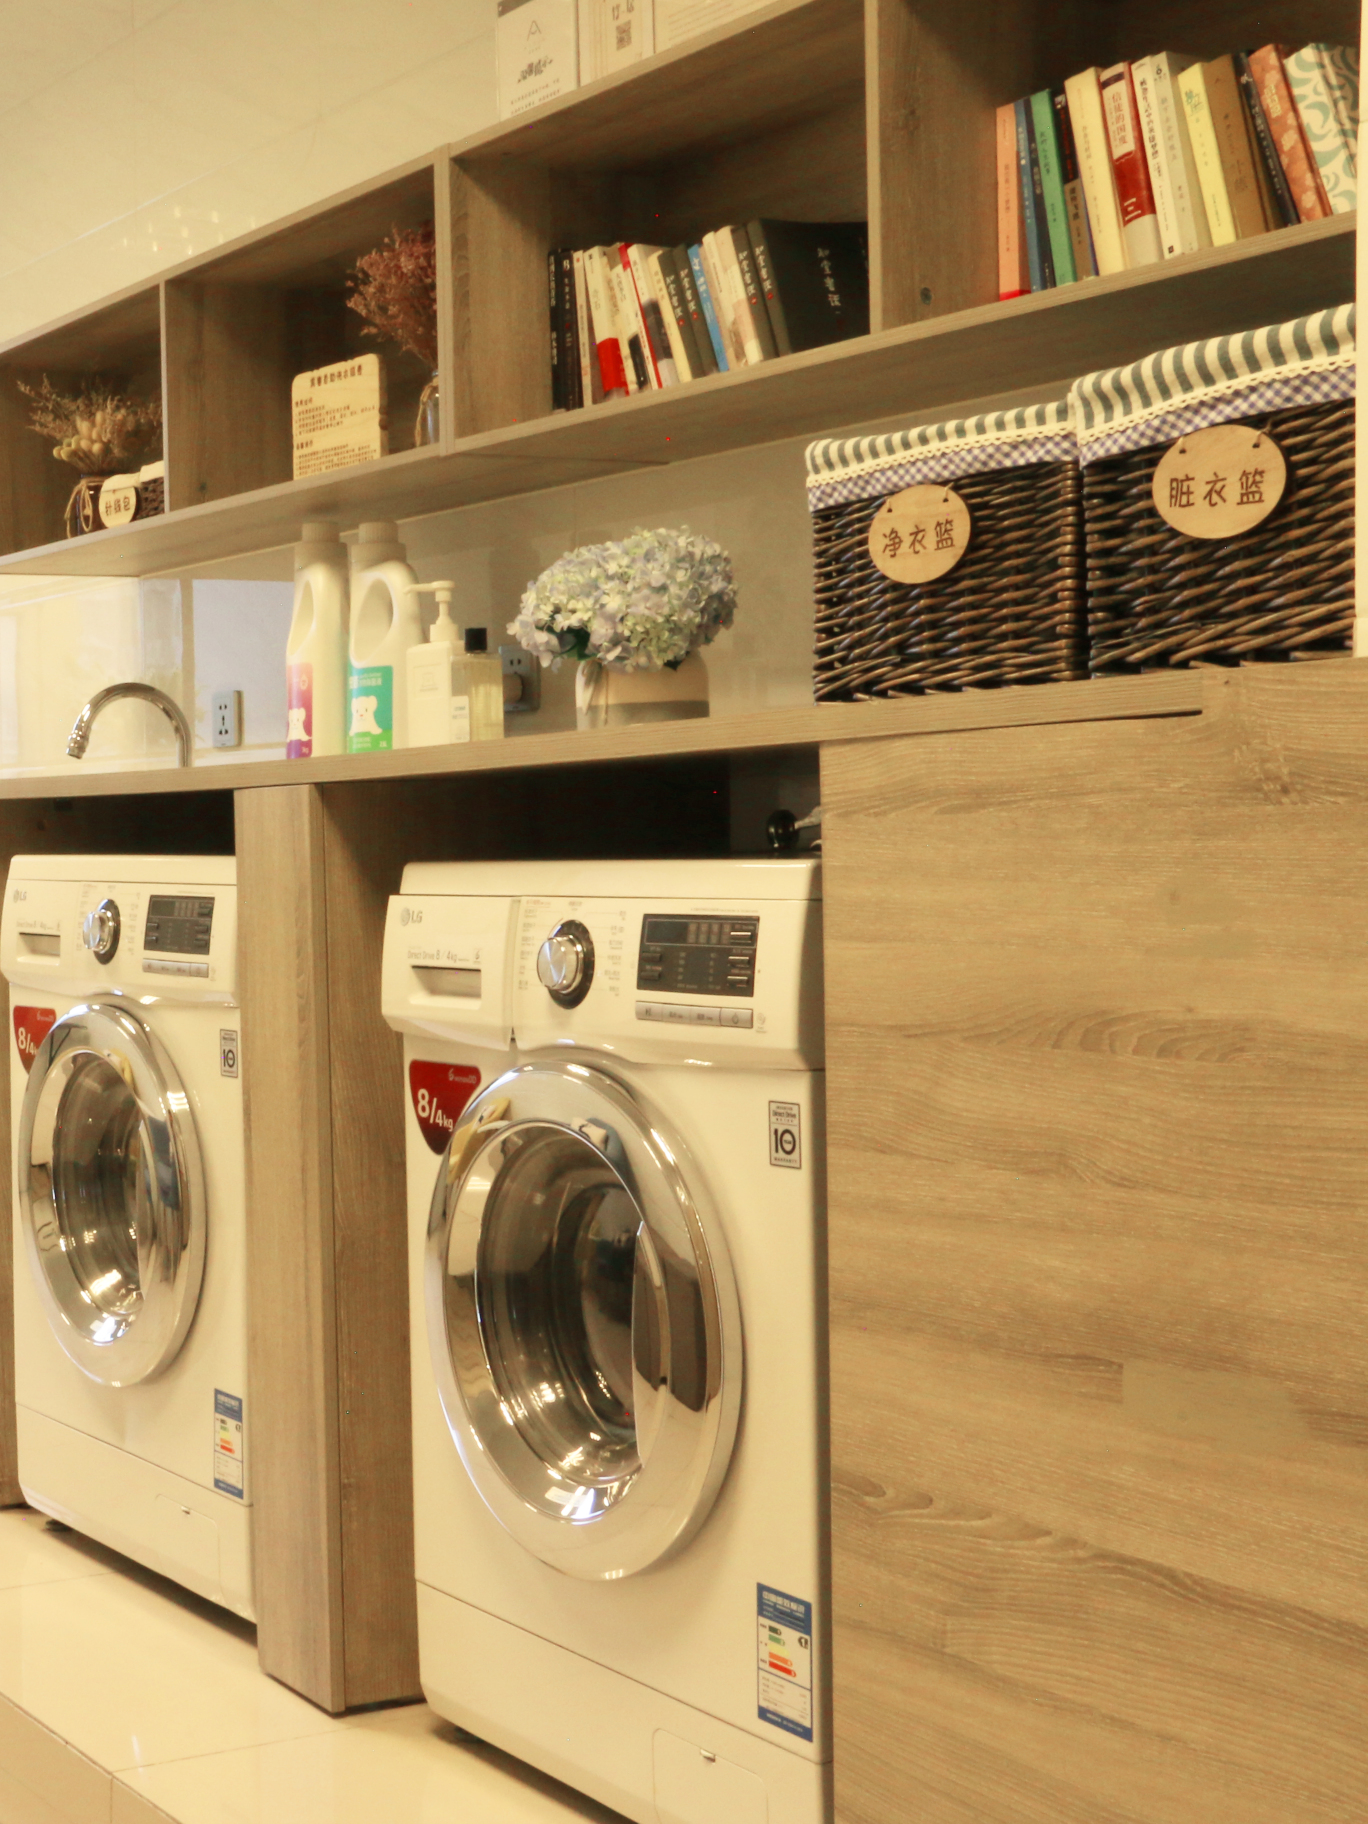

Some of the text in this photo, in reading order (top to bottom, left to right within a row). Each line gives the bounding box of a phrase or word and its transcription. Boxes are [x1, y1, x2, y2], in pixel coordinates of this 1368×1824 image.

[1169, 468, 1266, 509] 脏衣篮
[105, 496, 131, 516] 针线包
[881, 519, 956, 559] 净衣篮
[411, 910, 423, 923] LG
[223, 1049, 236, 1068] 10
[773, 1128, 797, 1155] 10
